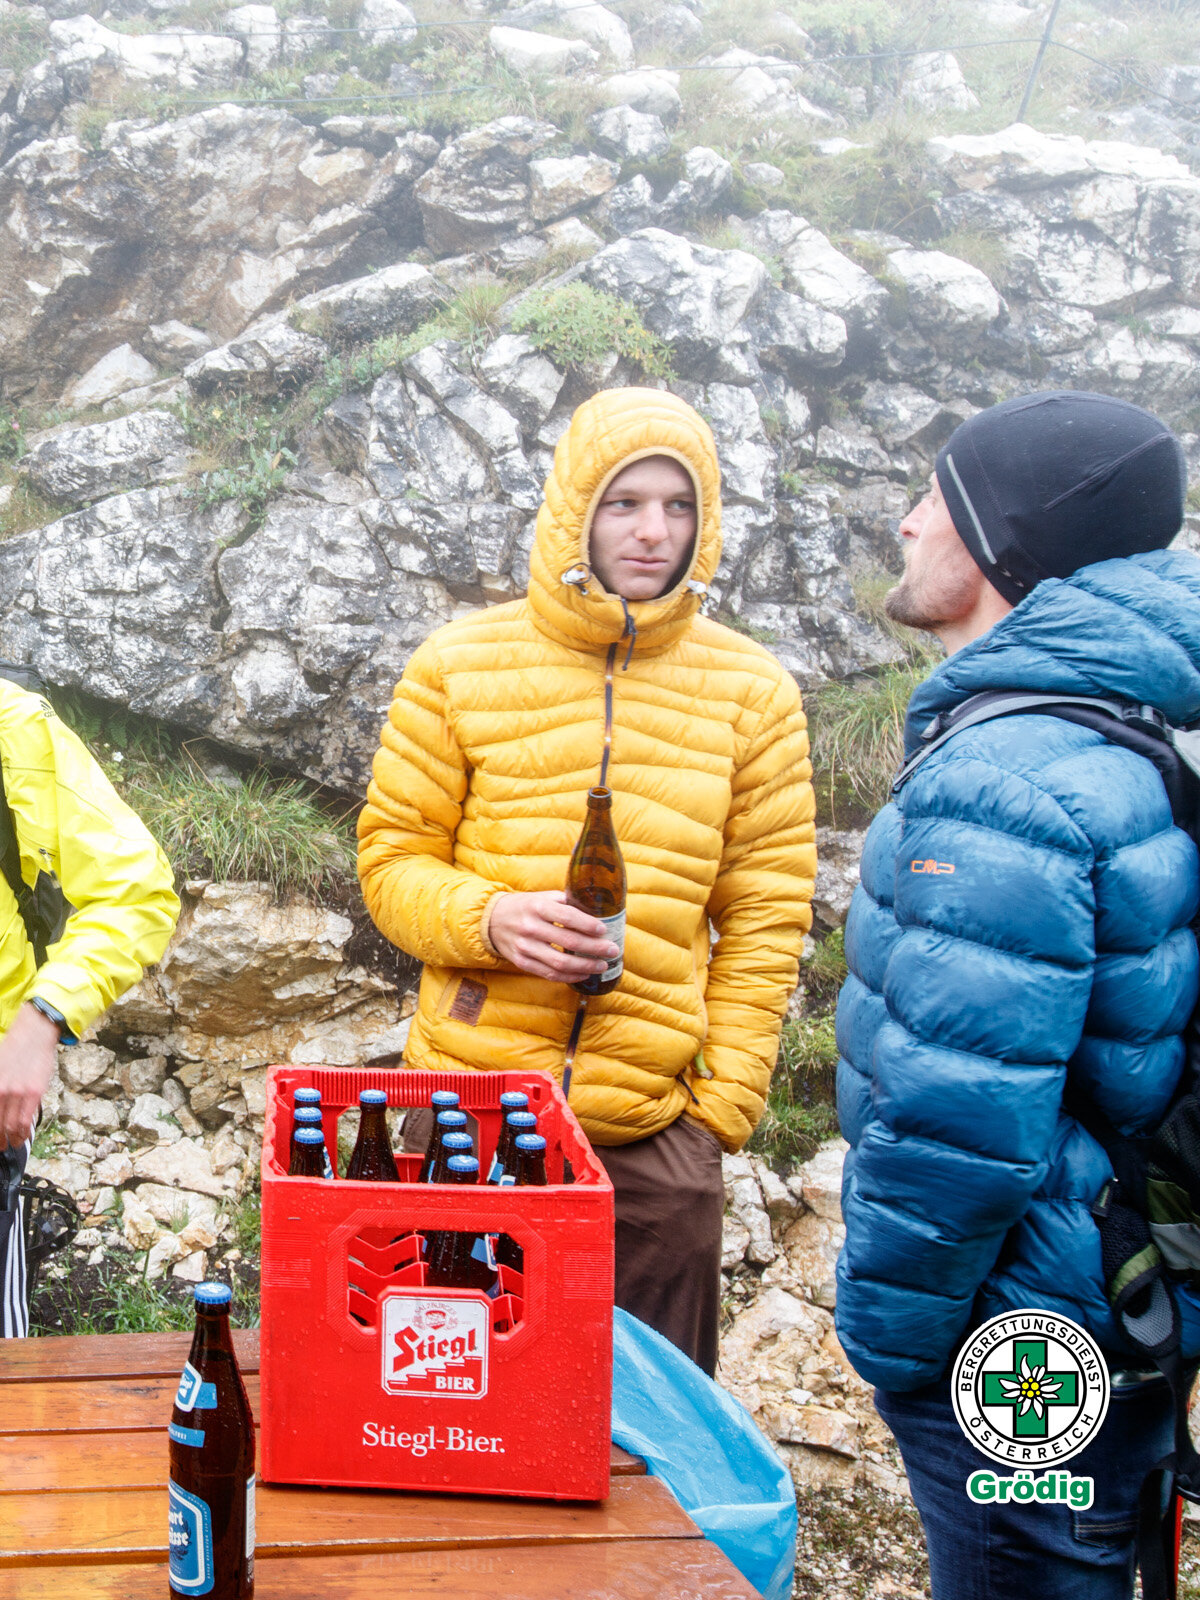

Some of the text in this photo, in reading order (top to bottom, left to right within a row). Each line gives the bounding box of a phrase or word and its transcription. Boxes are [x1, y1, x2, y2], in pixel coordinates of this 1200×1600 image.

[393, 1325, 476, 1373] Stiegl
[435, 1375, 475, 1391] BIER
[362, 1421, 506, 1457] Stiegl-Bier.
